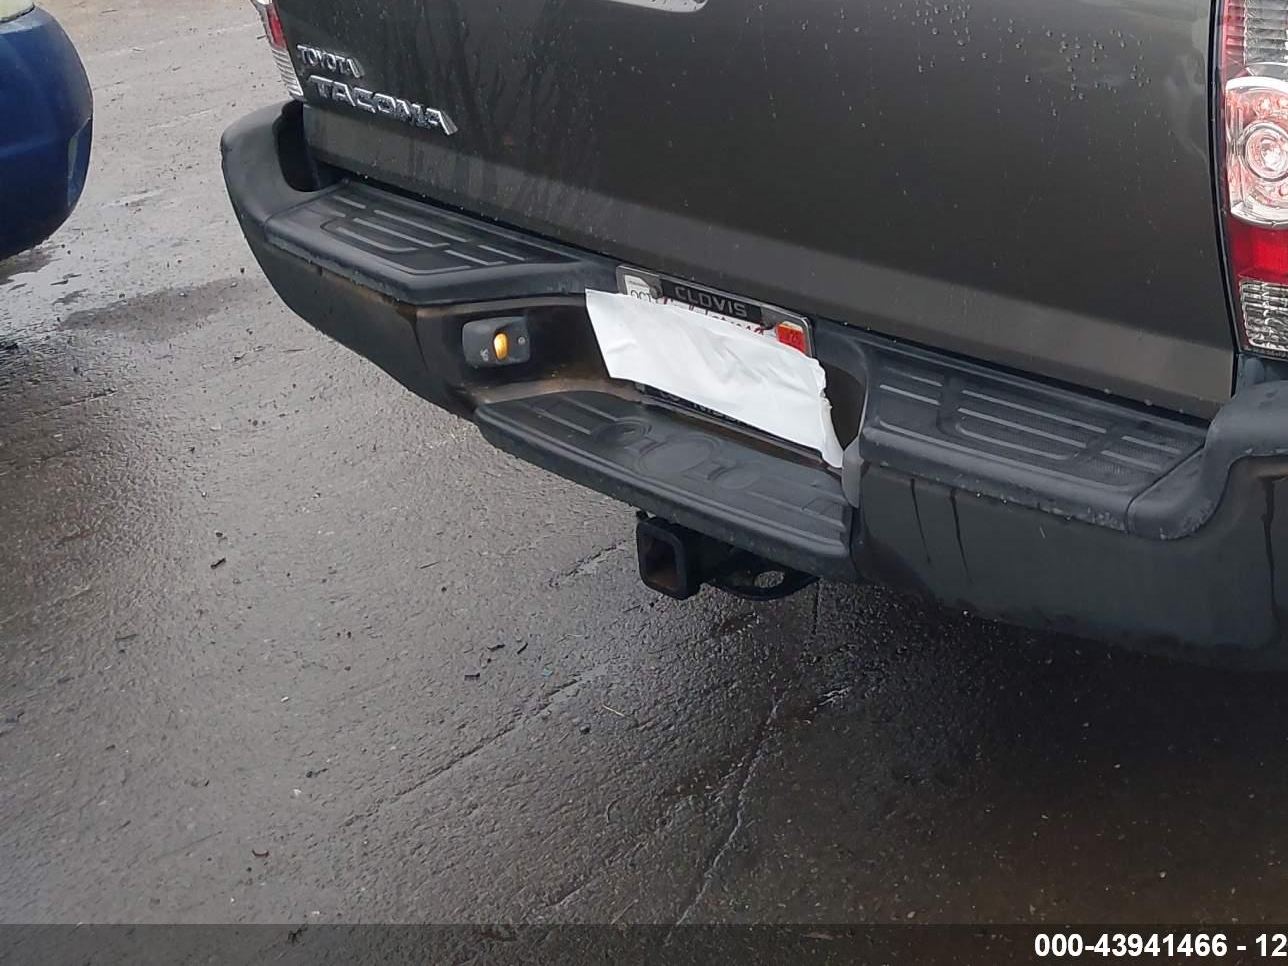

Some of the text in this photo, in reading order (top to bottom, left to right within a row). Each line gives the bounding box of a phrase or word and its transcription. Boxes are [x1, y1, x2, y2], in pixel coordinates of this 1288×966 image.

[297, 44, 365, 78] TOYOTA
[308, 74, 458, 136] TACOMA
[675, 286, 748, 318] CLOVIS
